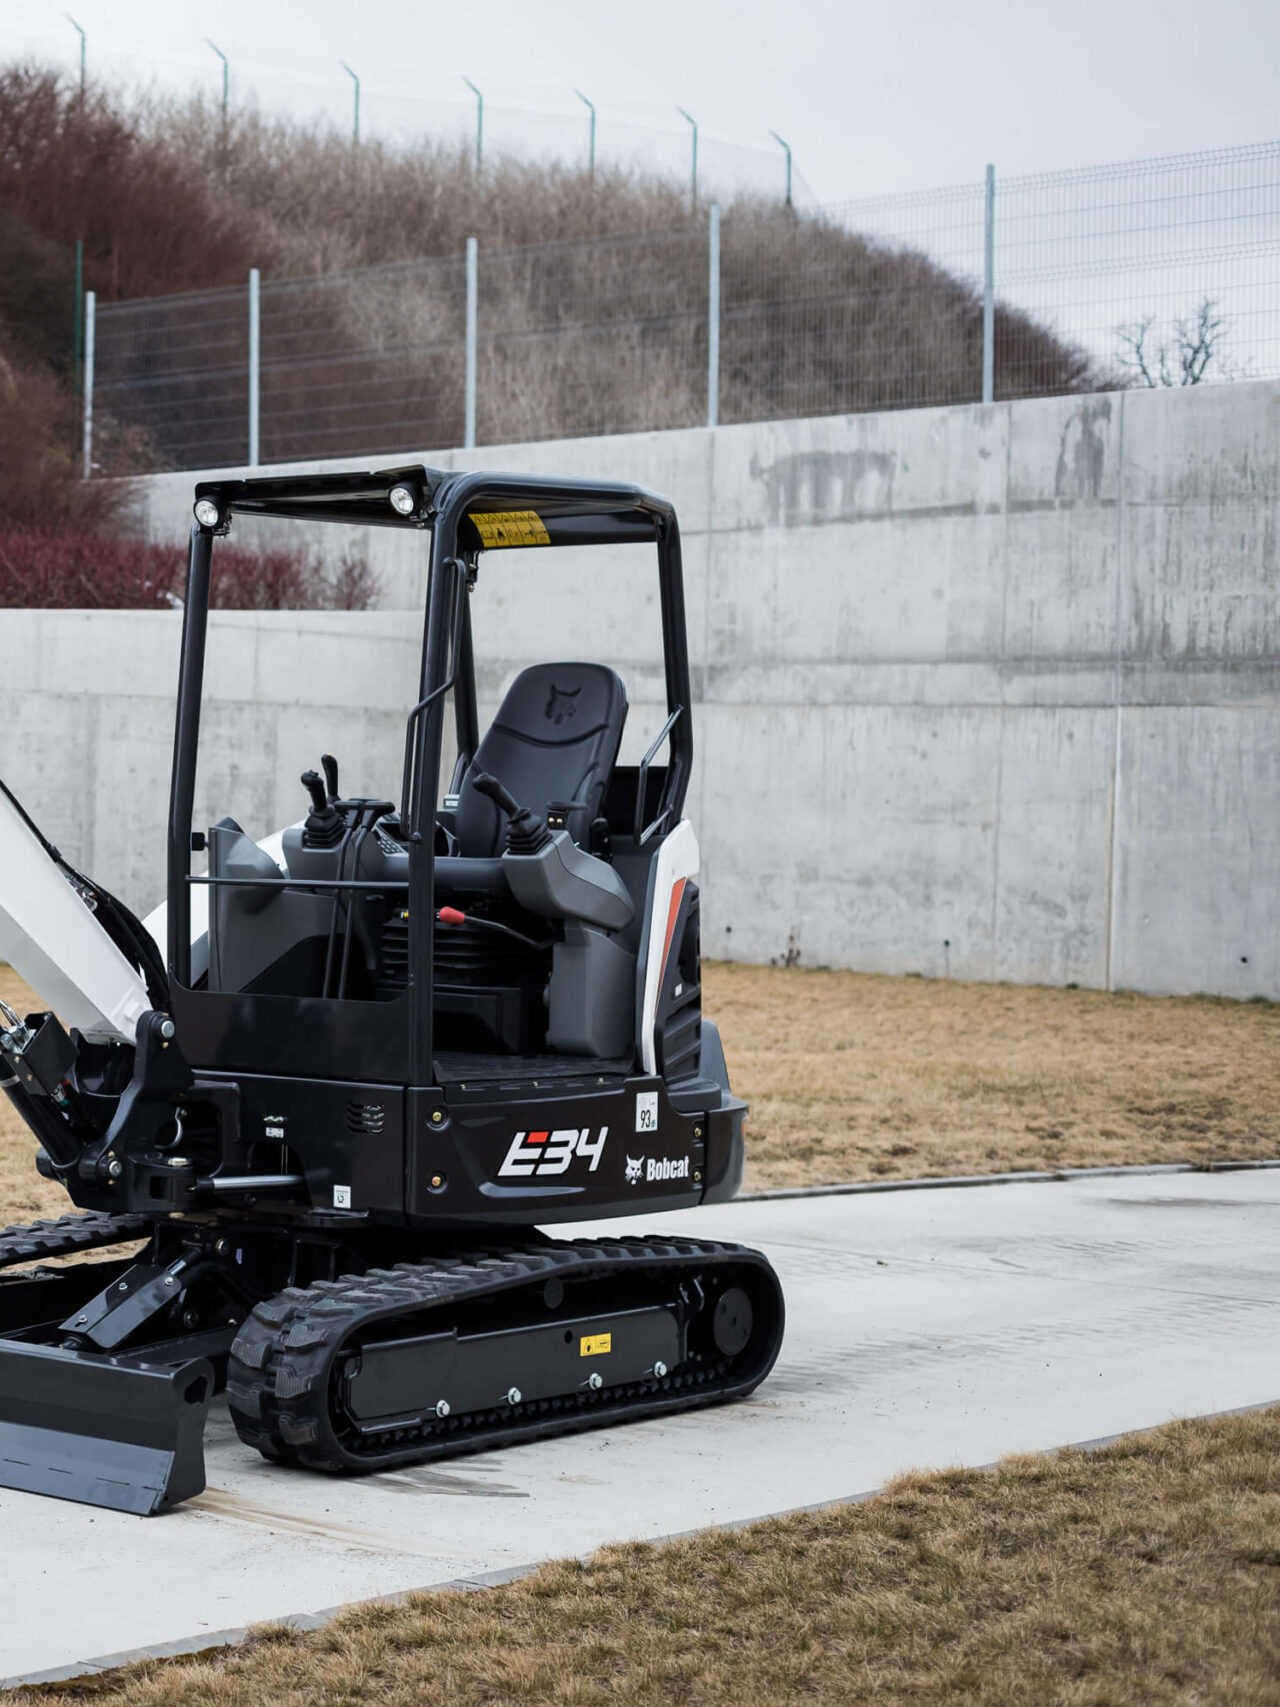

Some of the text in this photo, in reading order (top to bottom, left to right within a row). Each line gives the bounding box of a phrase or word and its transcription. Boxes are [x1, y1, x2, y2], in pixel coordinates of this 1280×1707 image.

[640, 1109, 651, 1129] 93
[497, 1126, 609, 1176] E34
[646, 1155, 689, 1181] Bobcat
